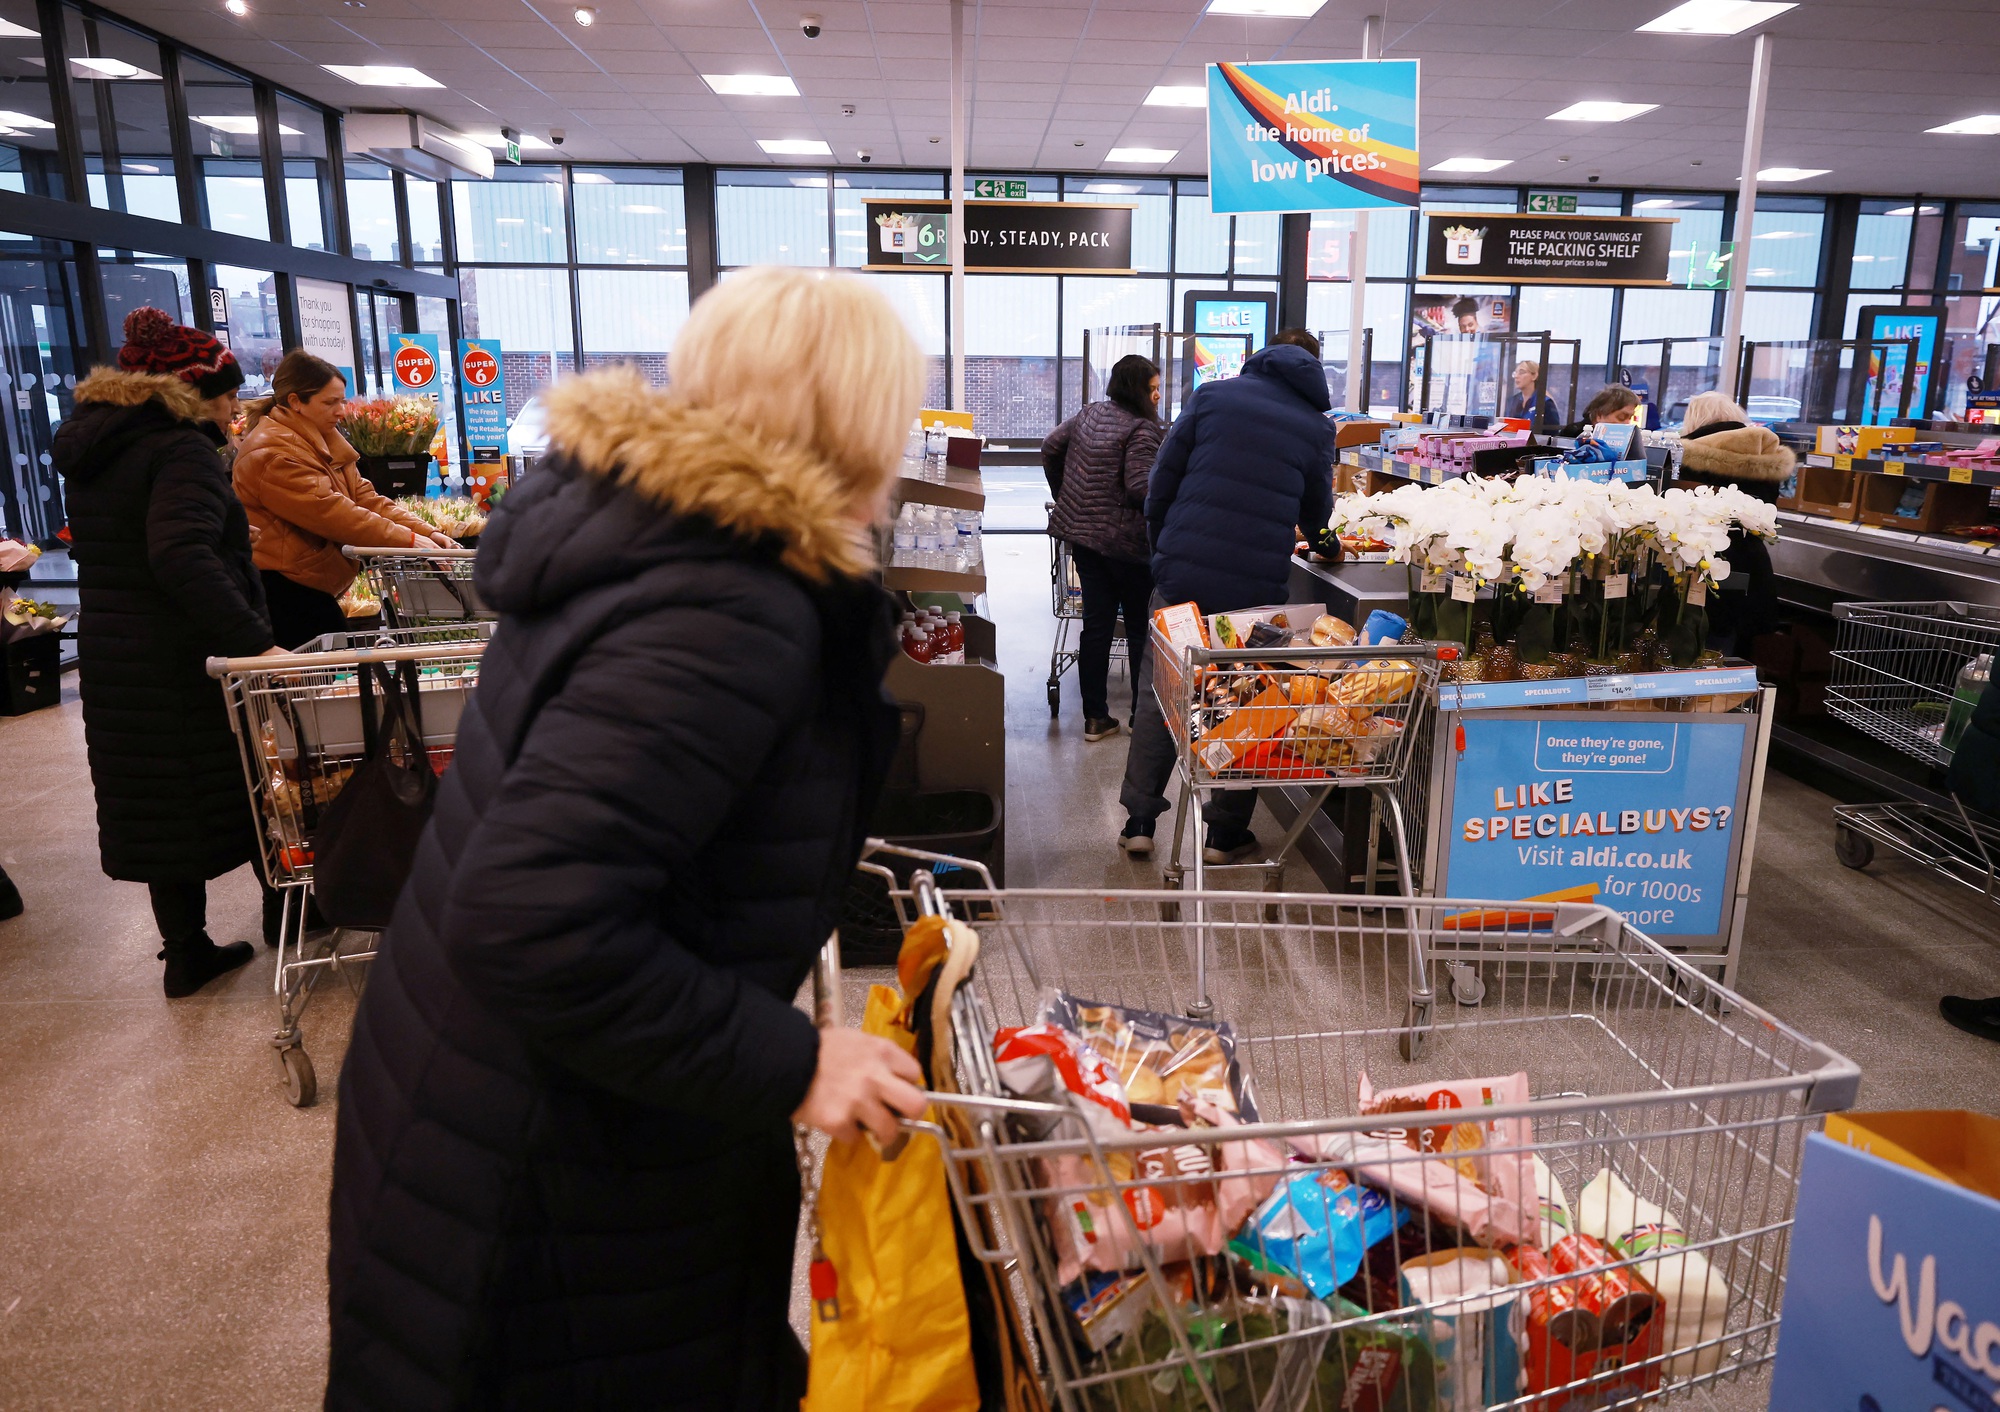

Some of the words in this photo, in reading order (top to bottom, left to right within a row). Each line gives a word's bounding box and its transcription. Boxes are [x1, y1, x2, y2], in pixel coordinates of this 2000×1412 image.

[1283, 88, 1339, 114] Aldi.
[1246, 123, 1281, 142] the
[1286, 123, 1344, 142] home
[1348, 124, 1370, 142] of
[1251, 159, 1298, 183] low
[1305, 149, 1387, 183] prices.
[1010, 182, 1025, 190] Fire
[919, 223, 936, 247] 6
[937, 229, 994, 247] RDY,
[999, 230, 1064, 248] STEADY,
[1069, 231, 1110, 247] PACK
[1510, 230, 1541, 239] PLEASE
[1544, 230, 1566, 240] PACK
[1568, 231, 1592, 240] YOUR
[1593, 232, 1630, 241] SAVINGS
[1631, 233, 1642, 242] AT
[1323, 240, 1340, 263] 5
[1509, 242, 1535, 256] THE
[1538, 243, 1595, 257] PACKING
[1598, 244, 1640, 258] SHELF
[1514, 257, 1533, 266] helps
[1534, 258, 1551, 266] keep
[1564, 259, 1585, 267] prices
[1595, 259, 1608, 267] low
[299, 296, 319, 310] Thank
[319, 300, 332, 314] you
[302, 314, 311, 327] for
[311, 316, 341, 333] shopping
[1884, 324, 1923, 339] LIKE
[304, 334, 318, 347] with
[319, 337, 326, 347] us
[326, 336, 346, 350] today!
[397, 358, 431, 367] SUPER
[466, 360, 495, 368] SUPER
[409, 367, 422, 383] 6
[475, 368, 487, 383] 6
[465, 390, 503, 405] LIKE
[1468, 441, 1496, 453] Skinny
[1695, 677, 1742, 686] SPECIALBUYS
[1440, 692, 1486, 701] SPECALBUYS
[1524, 687, 1571, 696] SPECIALBUYS
[1547, 736, 1578, 747] Once
[1581, 736, 1626, 750] they're
[1628, 737, 1665, 751] gone,
[1561, 752, 1606, 764] they're
[1609, 753, 1647, 766] gone!
[1494, 778, 1574, 811] LIKE
[1463, 806, 1732, 842] SPECIALBUYS?
[1518, 845, 1564, 866] Visit
[1570, 847, 1693, 870] aldi.co.uk
[1604, 875, 1636, 896] for
[1640, 880, 1702, 904] 1000s
[1616, 908, 1674, 926] more
